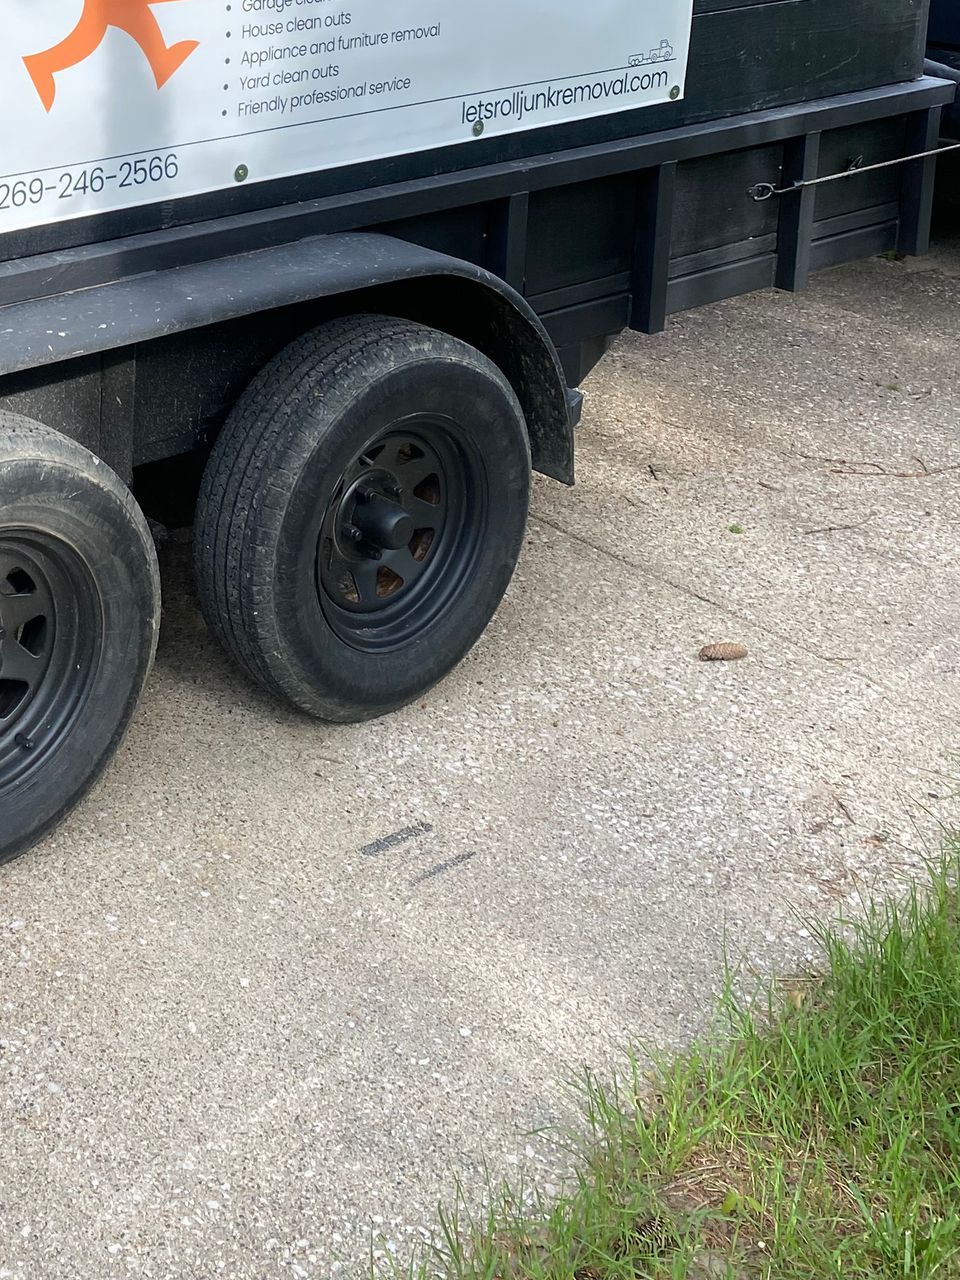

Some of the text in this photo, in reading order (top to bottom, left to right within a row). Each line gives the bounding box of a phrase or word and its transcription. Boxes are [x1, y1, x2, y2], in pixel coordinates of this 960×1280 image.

[240, 22, 441, 68] Appliance and furniture removal
[241, 11, 352, 39] House clean outs
[238, 76, 411, 117] Friendly professional service
[239, 64, 340, 91] Yard clean outs
[461, 70, 668, 124] letsrolljunkremoval.com
